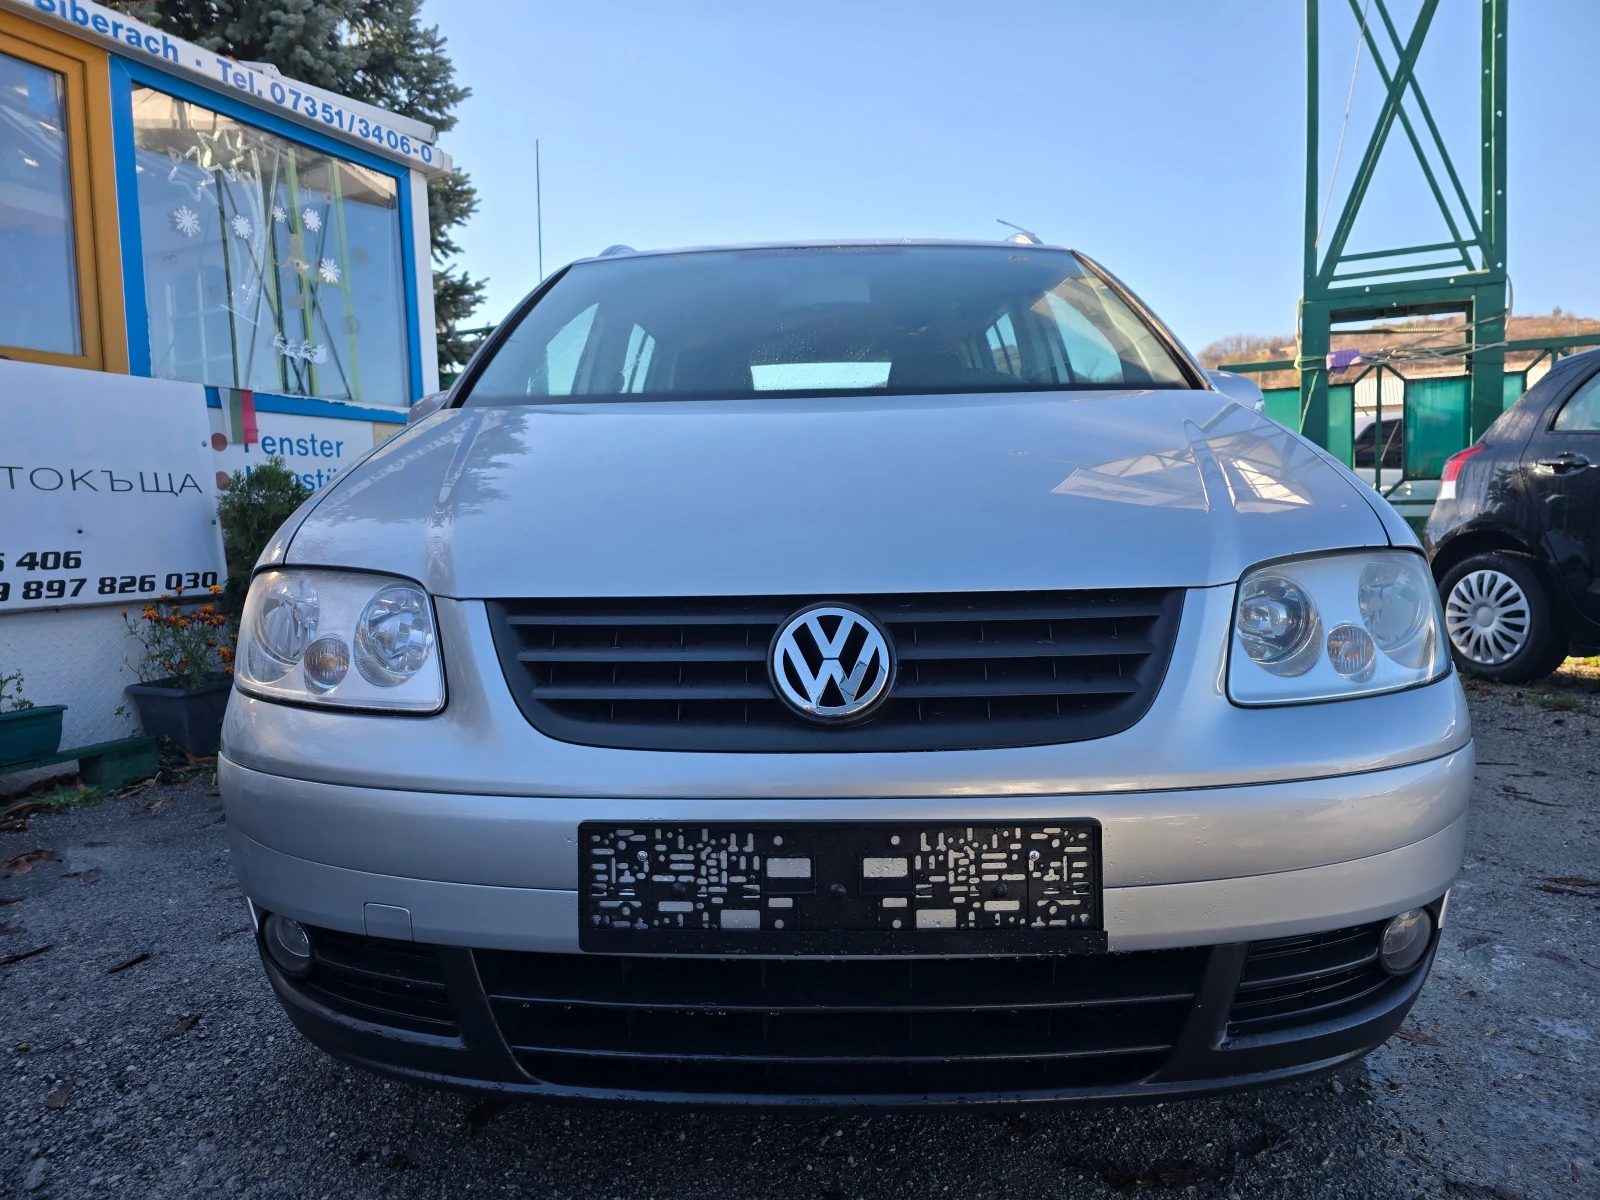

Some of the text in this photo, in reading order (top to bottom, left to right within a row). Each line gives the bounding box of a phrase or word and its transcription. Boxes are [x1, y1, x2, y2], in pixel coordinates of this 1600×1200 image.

[216, 57, 263, 97] Tel.
[270, 81, 433, 164] 07351/3406-0
[0, 466, 203, 497] ТОКЪЩА
[15, 551, 82, 571] 406
[22, 578, 88, 600] 897
[97, 574, 156, 595] 826
[165, 571, 218, 591] 030
